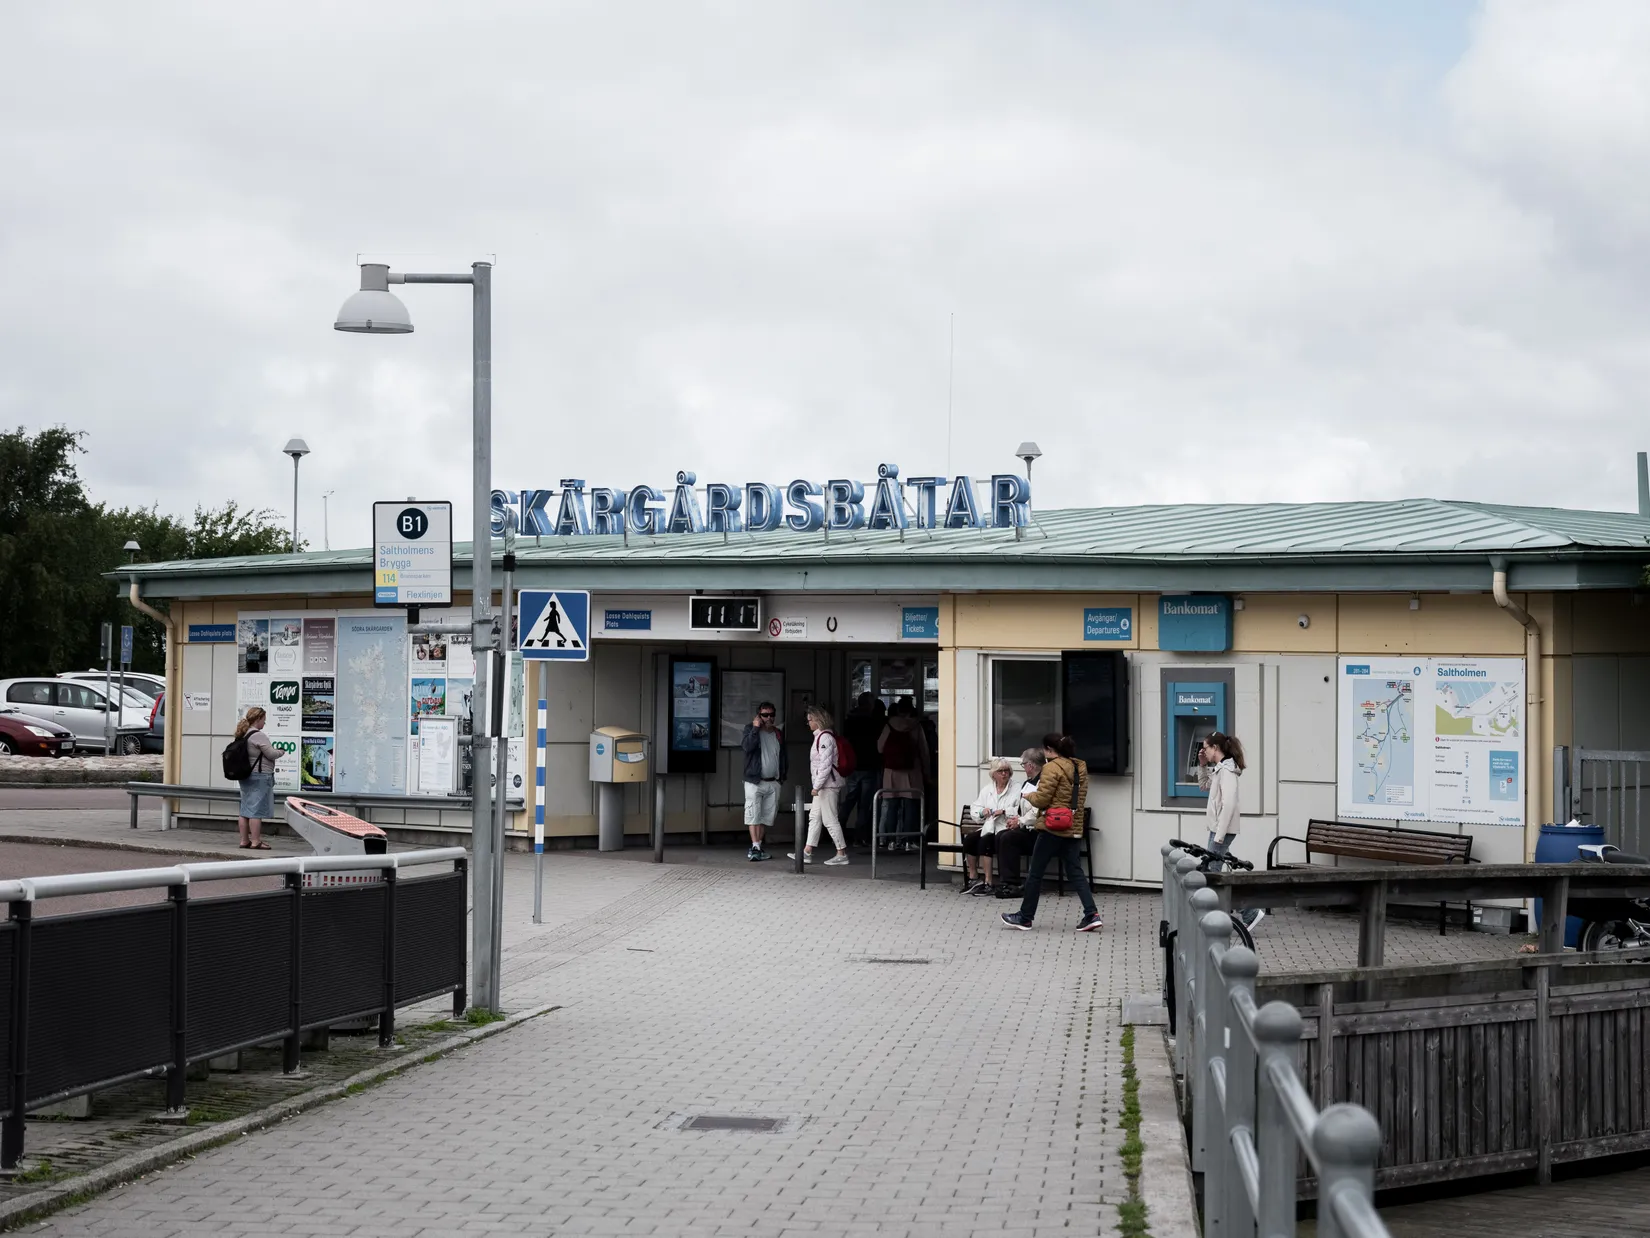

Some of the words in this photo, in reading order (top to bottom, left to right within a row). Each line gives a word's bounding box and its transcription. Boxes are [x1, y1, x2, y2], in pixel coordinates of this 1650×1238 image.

[491, 463, 1031, 537] SKÄRGÅRDSBÅTAR
[402, 515, 422, 533] B1
[380, 545, 434, 555] Saltholmens
[380, 559, 411, 570] Brygga
[383, 573, 396, 583] 114
[407, 591, 442, 601] Flexlinjen
[1163, 601, 1218, 615] Bankomat
[1087, 613, 1118, 624] Avgångar/
[905, 624, 925, 633] Tickets
[1087, 625, 1120, 635] Departures
[1437, 667, 1487, 677] Saltholmen
[1178, 694, 1211, 704] Bankomat
[271, 741, 297, 755] coop
